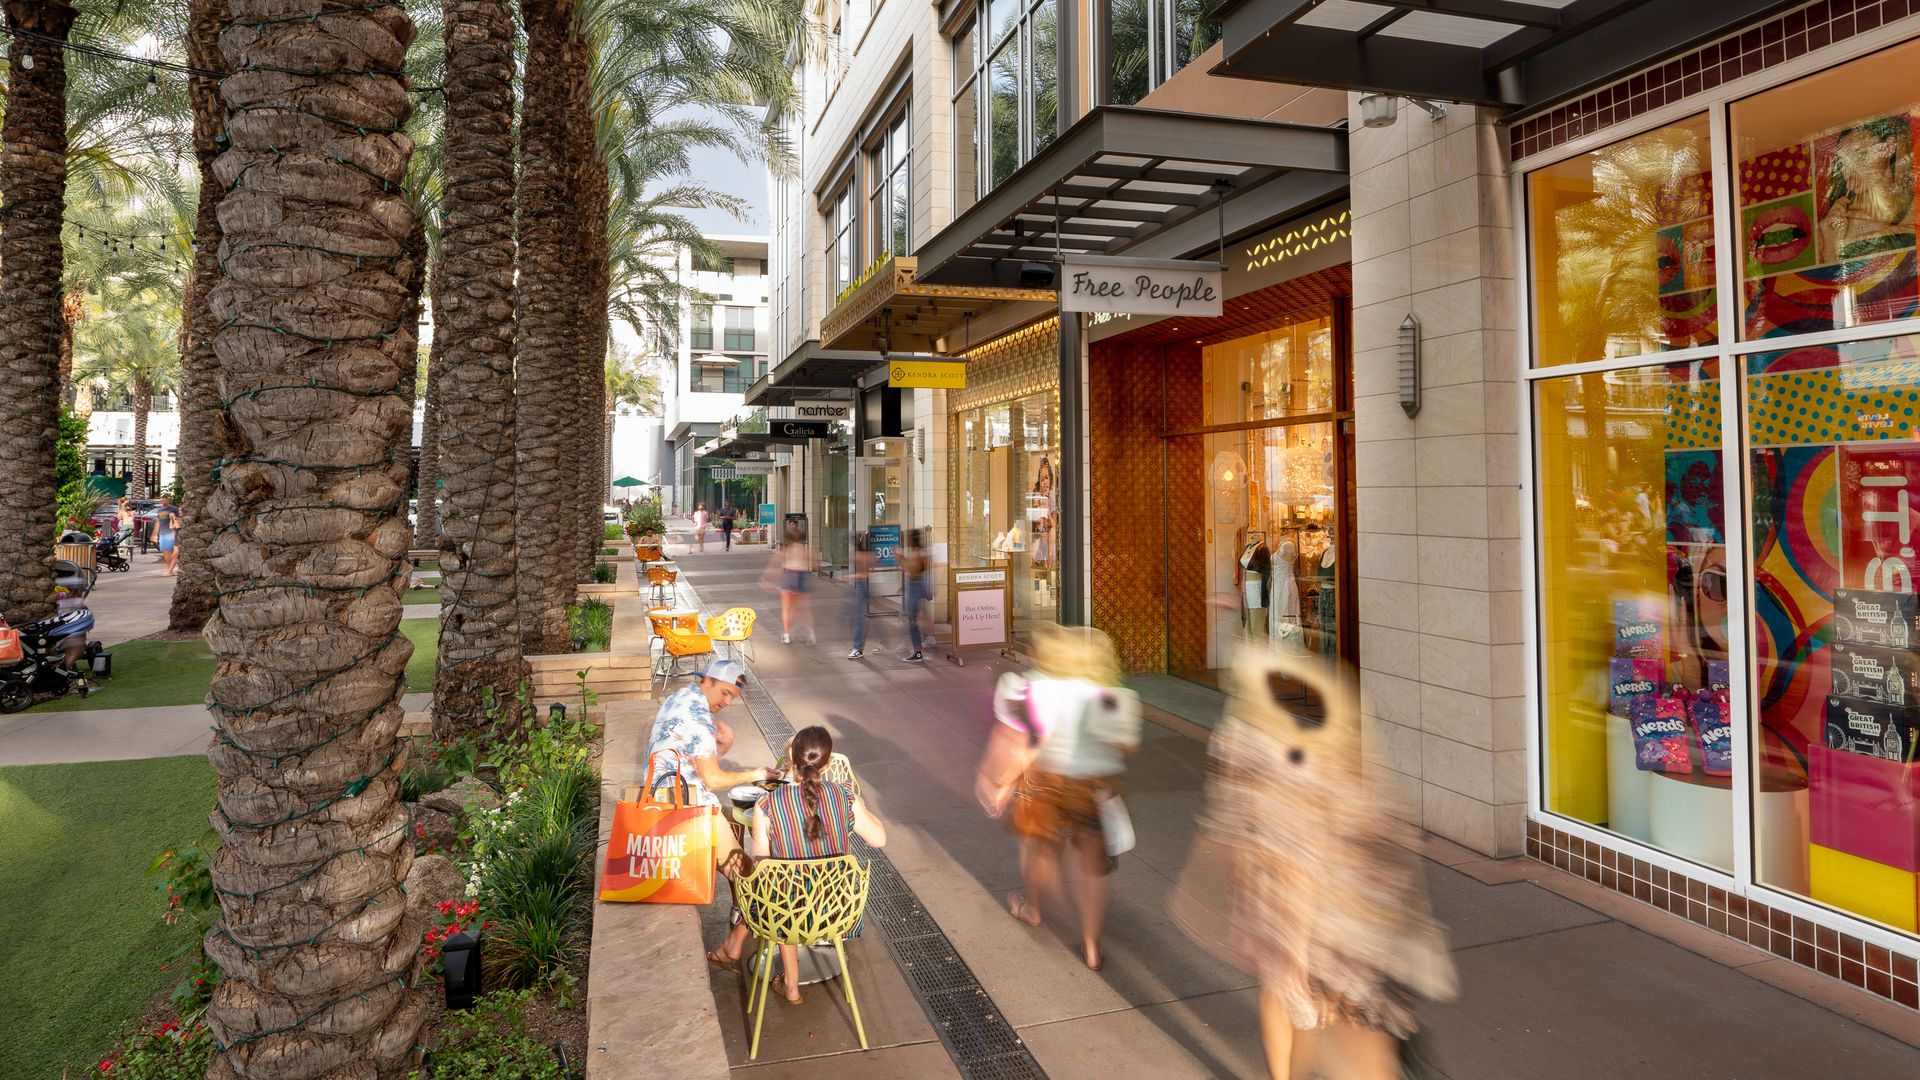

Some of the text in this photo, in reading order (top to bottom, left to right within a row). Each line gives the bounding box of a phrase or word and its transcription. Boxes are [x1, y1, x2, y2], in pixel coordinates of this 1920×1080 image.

[1073, 271, 1217, 309] Free People
[783, 422, 815, 435] Galicia
[1850, 722, 1880, 730] BRITISH
[626, 833, 687, 857] MARINE
[629, 856, 681, 880] LAYER
